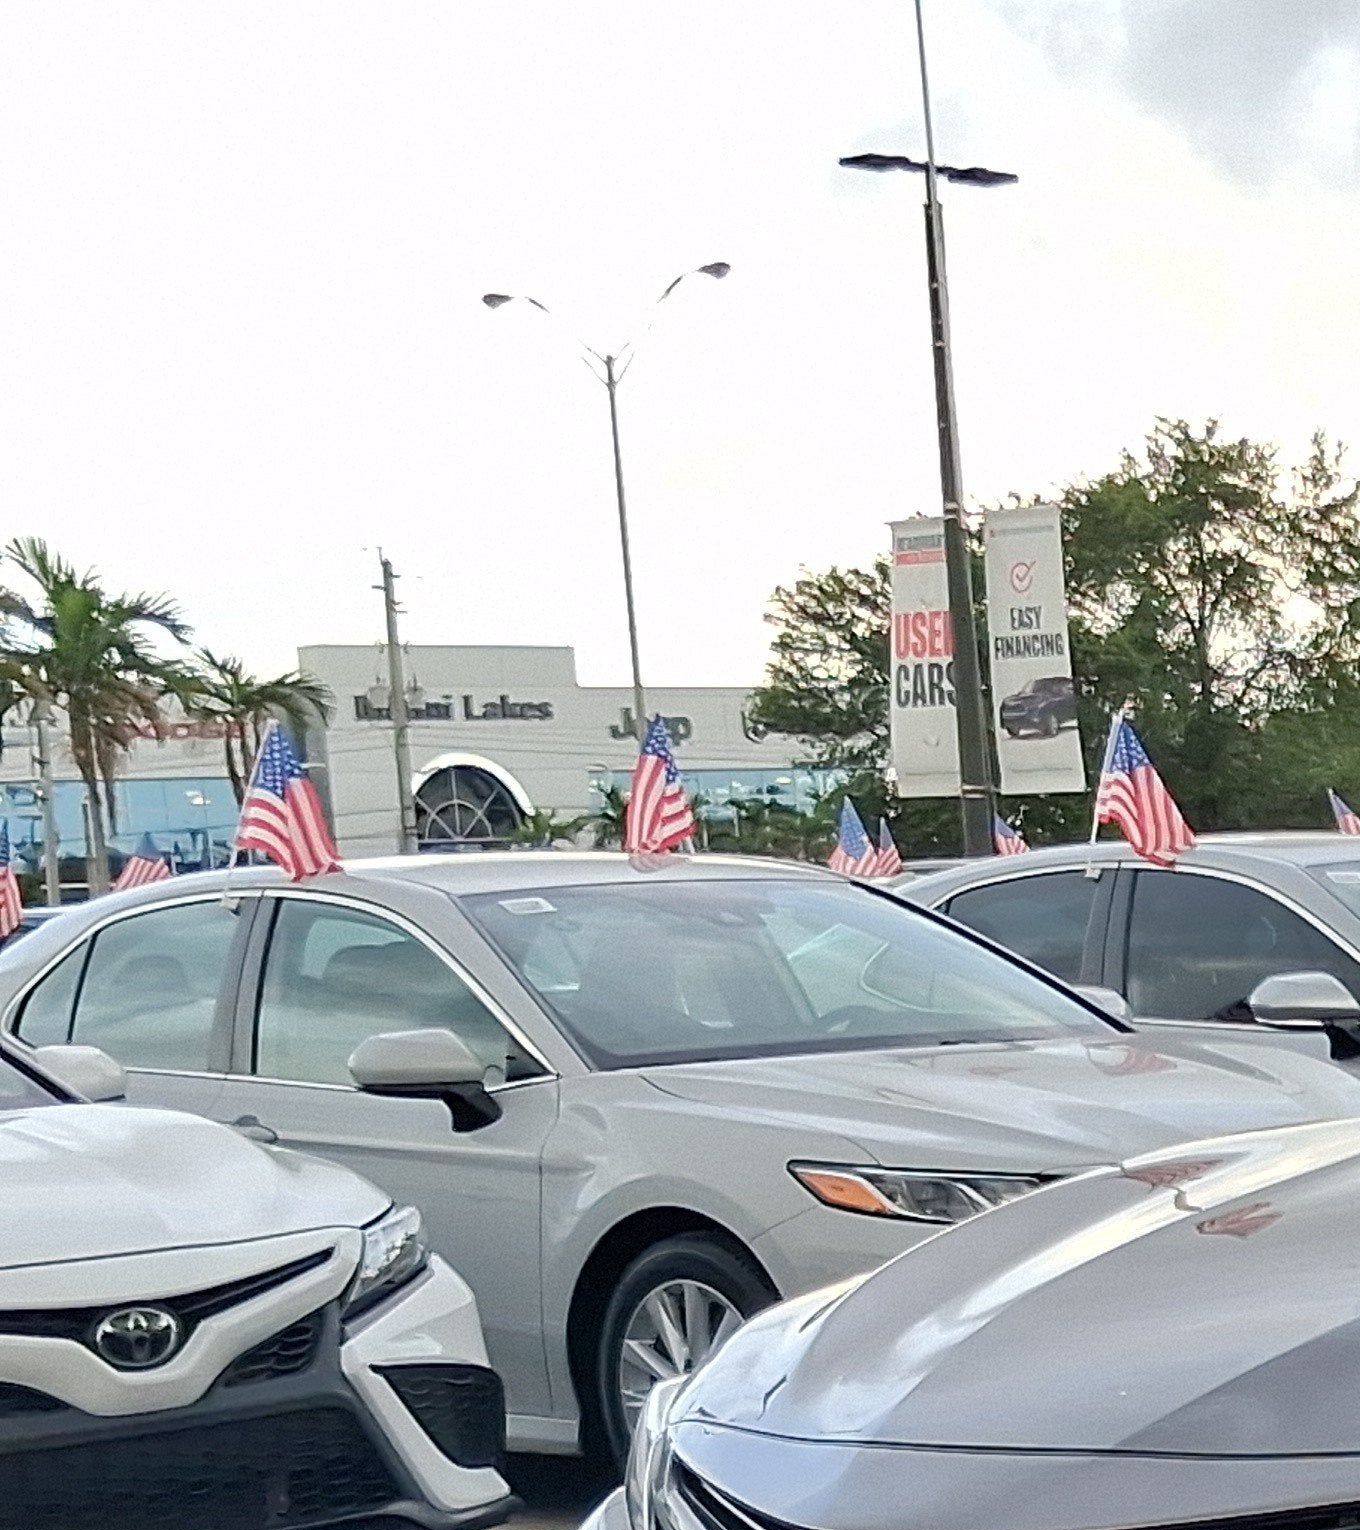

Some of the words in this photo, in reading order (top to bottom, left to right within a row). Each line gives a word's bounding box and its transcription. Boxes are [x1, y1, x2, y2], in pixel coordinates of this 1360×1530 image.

[1010, 605, 1042, 630] EASY
[995, 633, 1064, 660] FINANCING
[463, 694, 554, 721] Lakes
